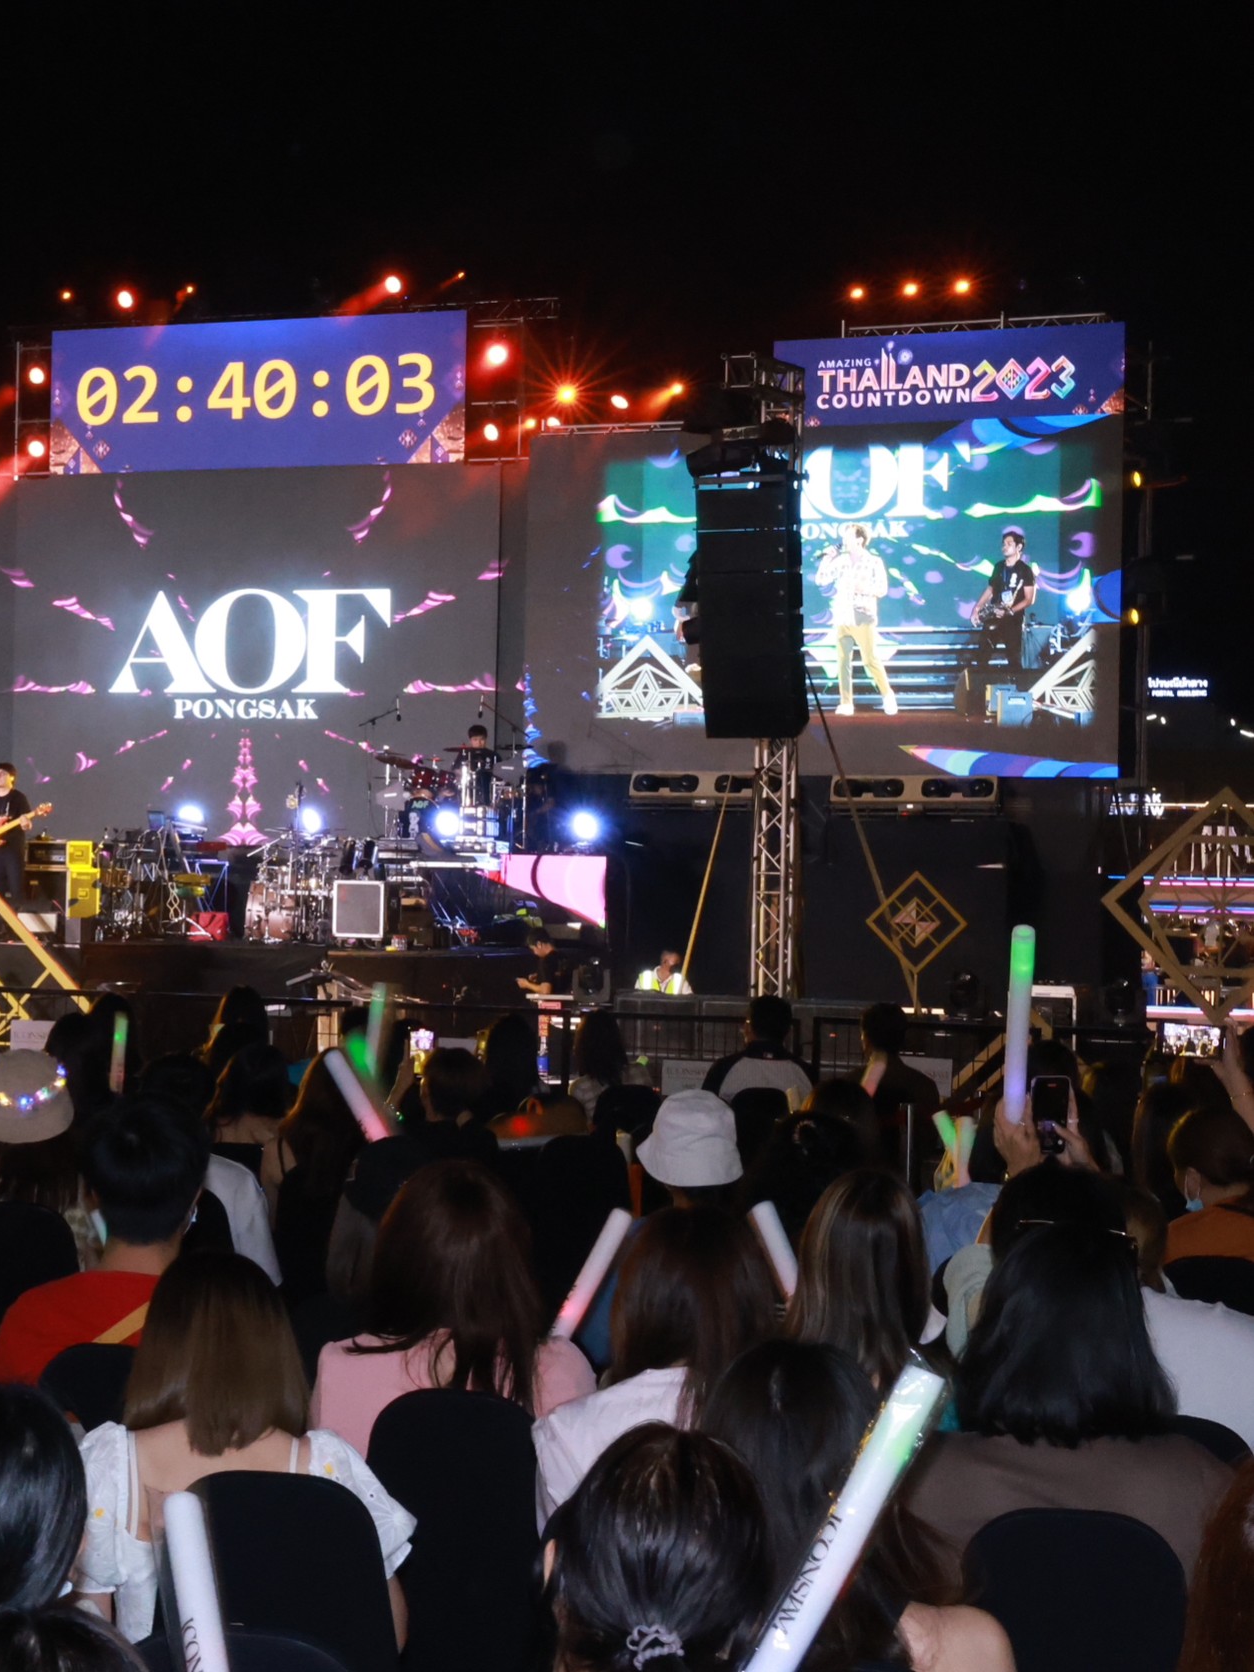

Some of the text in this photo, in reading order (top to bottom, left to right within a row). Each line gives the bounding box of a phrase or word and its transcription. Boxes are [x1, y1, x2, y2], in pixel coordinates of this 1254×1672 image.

[817, 348, 971, 392] THAILAND
[818, 358, 872, 368] AMAZING
[971, 355, 1076, 403] 2023
[76, 352, 436, 426] 02:40:03
[816, 388, 970, 410] COUNTDOWN
[108, 588, 391, 694] AOF
[174, 698, 318, 720] PONGSAK
